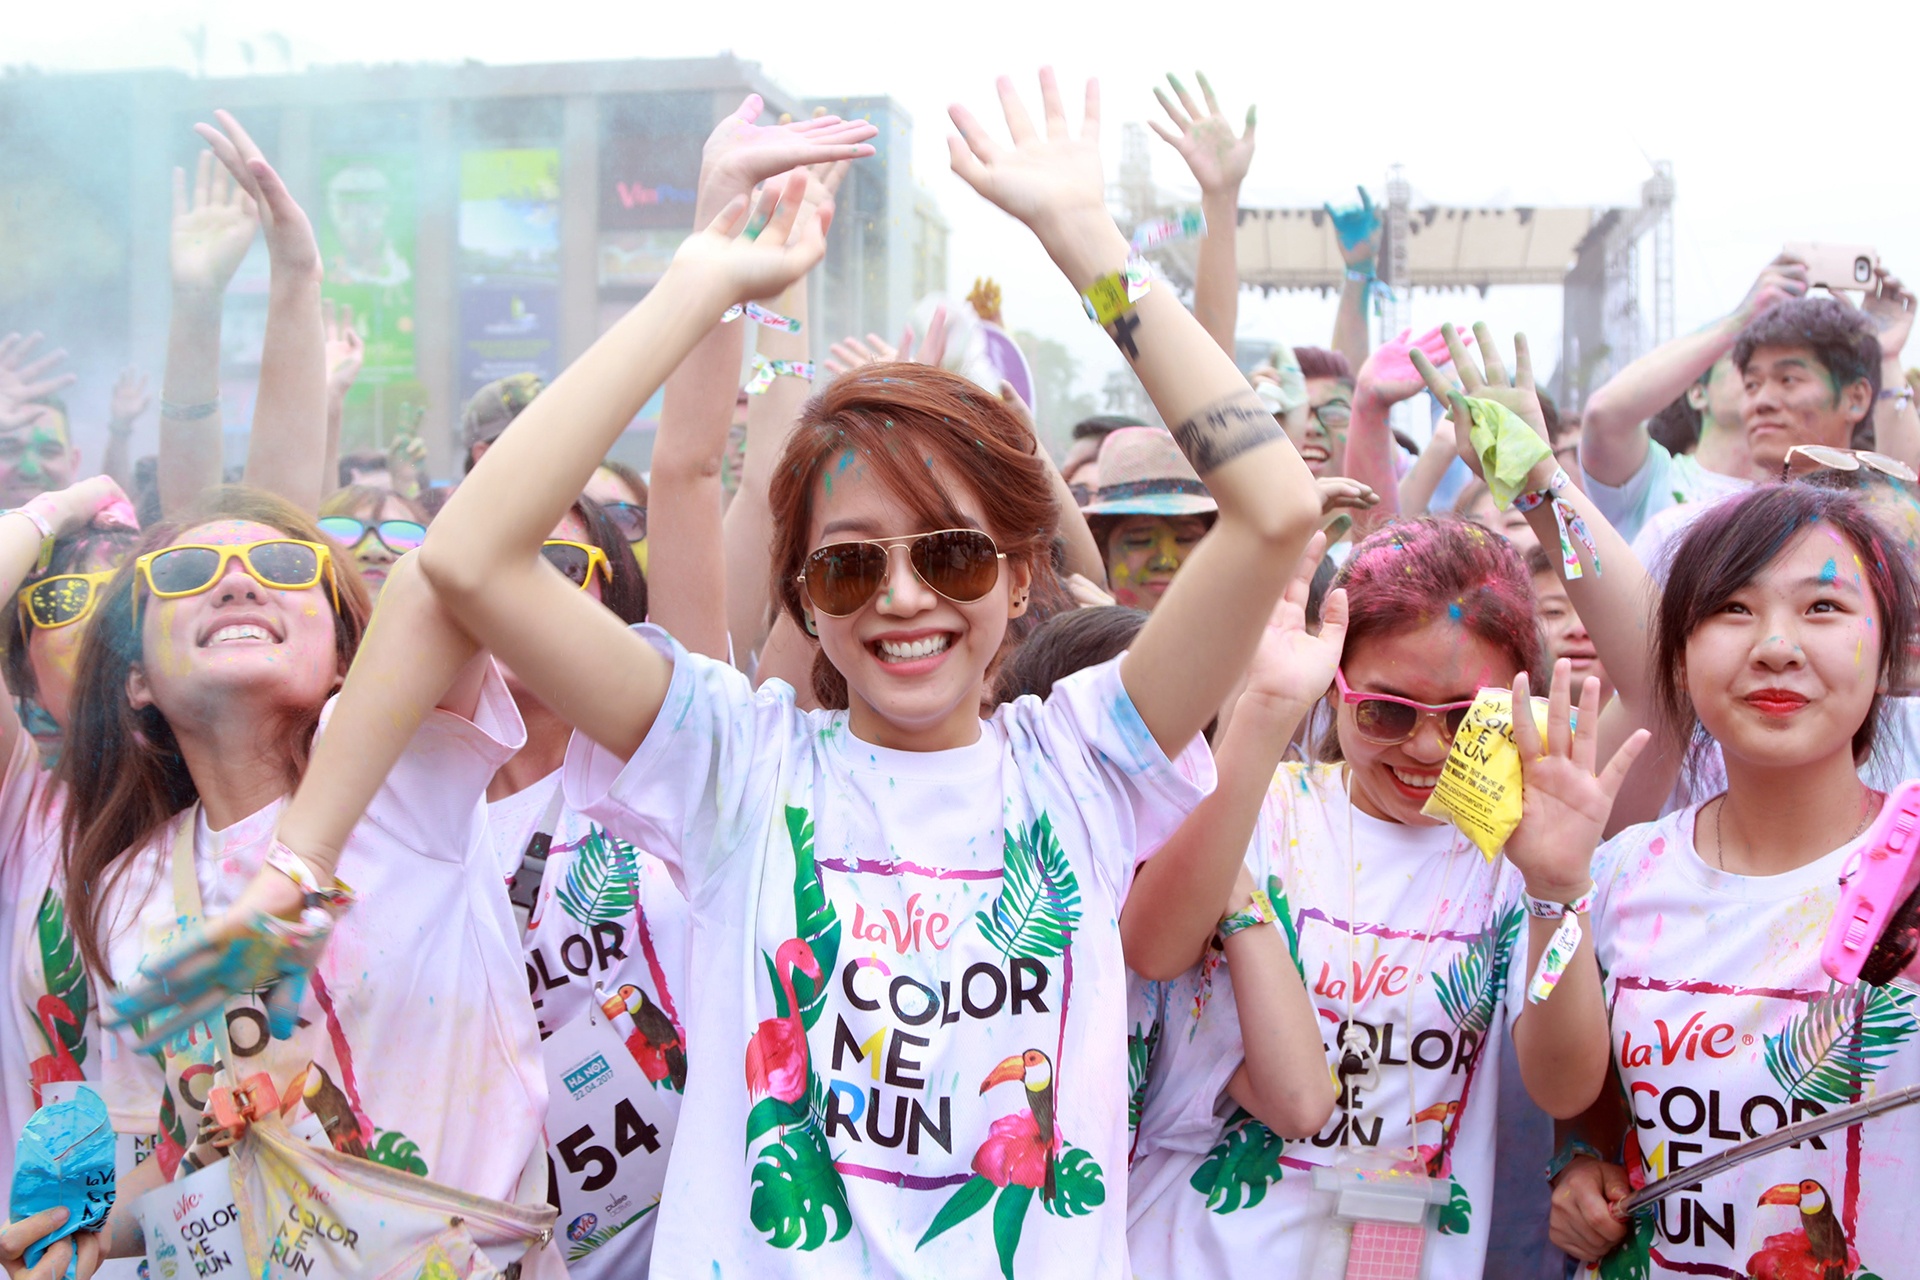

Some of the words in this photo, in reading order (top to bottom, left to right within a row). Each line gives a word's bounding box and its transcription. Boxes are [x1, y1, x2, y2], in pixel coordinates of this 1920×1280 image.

[842, 956, 1050, 1029] COLOR
[832, 1013, 930, 1090] ME
[573, 1069, 613, 1100] 22.04.2017
[825, 1079, 953, 1155] RUN
[289, 1204, 359, 1250] COLOR
[187, 1237, 214, 1261] ME
[195, 1250, 232, 1279] RUN
[270, 1241, 315, 1277] RUN
